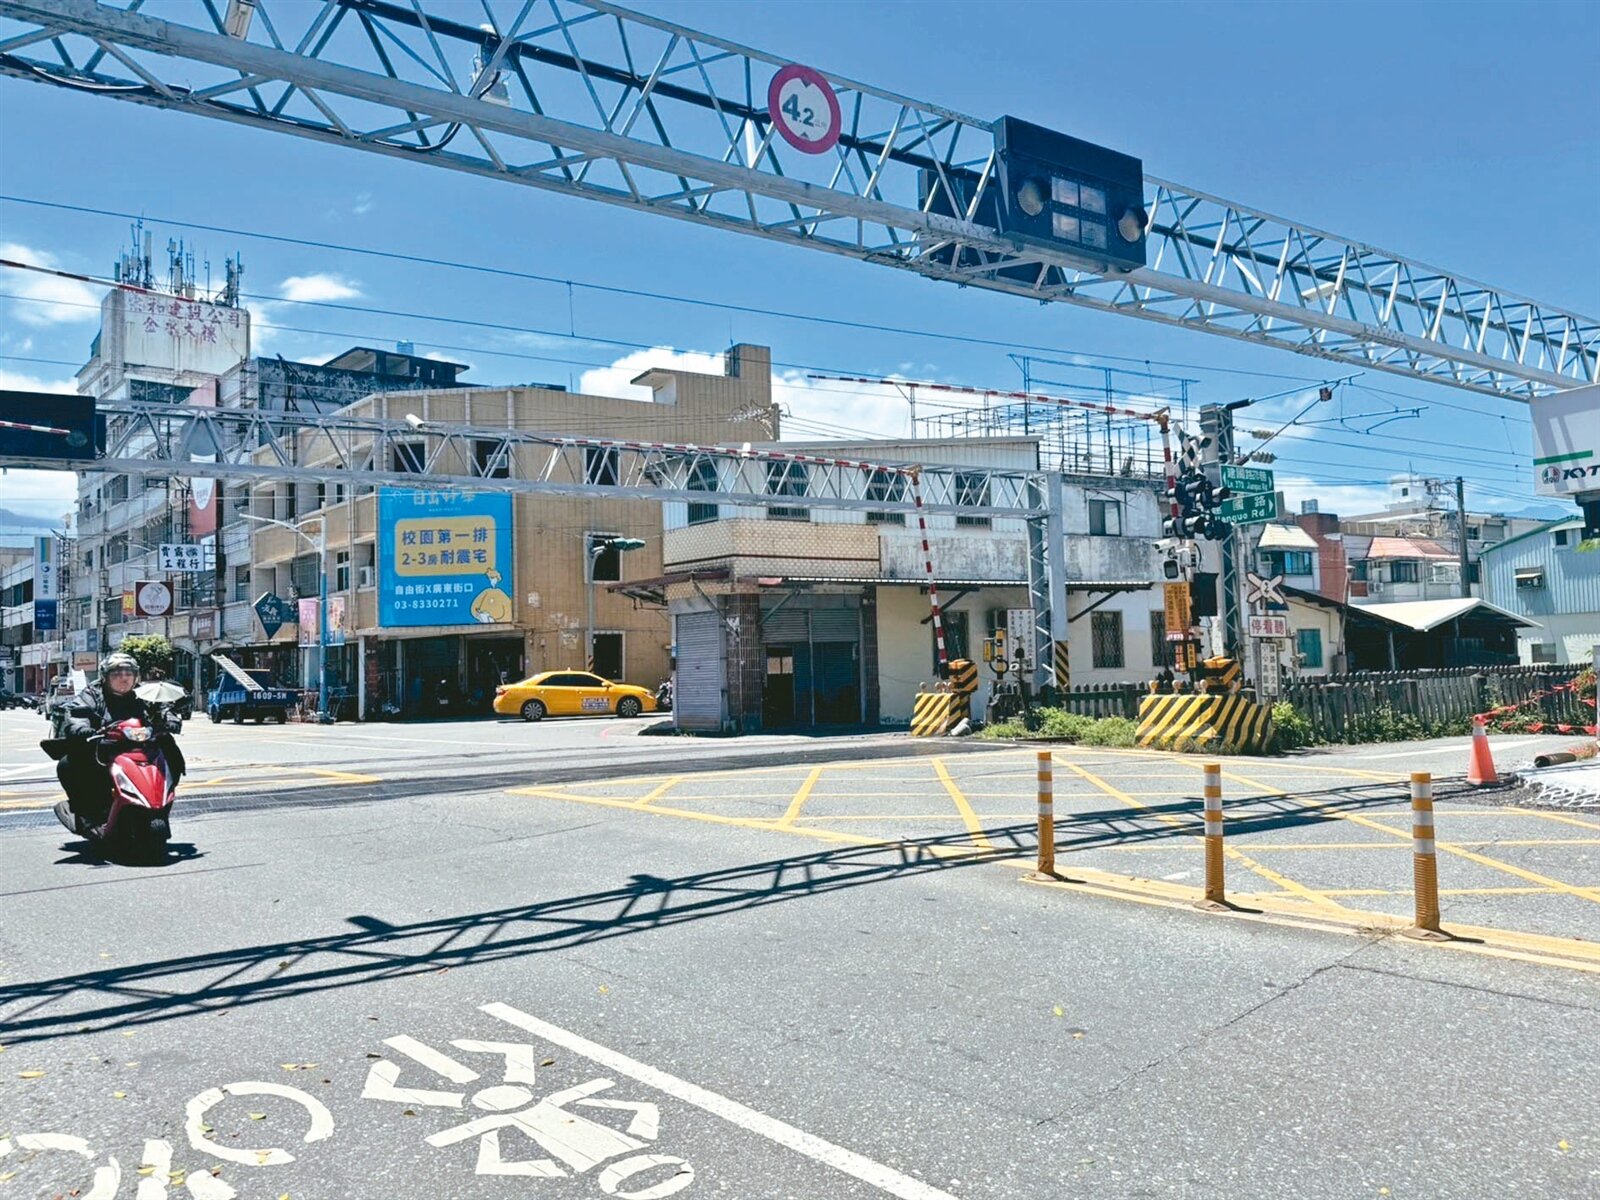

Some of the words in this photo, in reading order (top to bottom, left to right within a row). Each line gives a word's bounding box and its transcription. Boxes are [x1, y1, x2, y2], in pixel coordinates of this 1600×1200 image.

[781, 93, 815, 128] 4.2
[1251, 508, 1266, 519] Rd
[402, 527, 488, 545] 校園第一排
[164, 559, 200, 570] 工程行
[401, 548, 488, 566] 2-3房耐震宅
[395, 582, 474, 596] 自由街X廣東街口
[394, 598, 459, 611] 03-8330271
[1251, 618, 1285, 635] 停看聽
